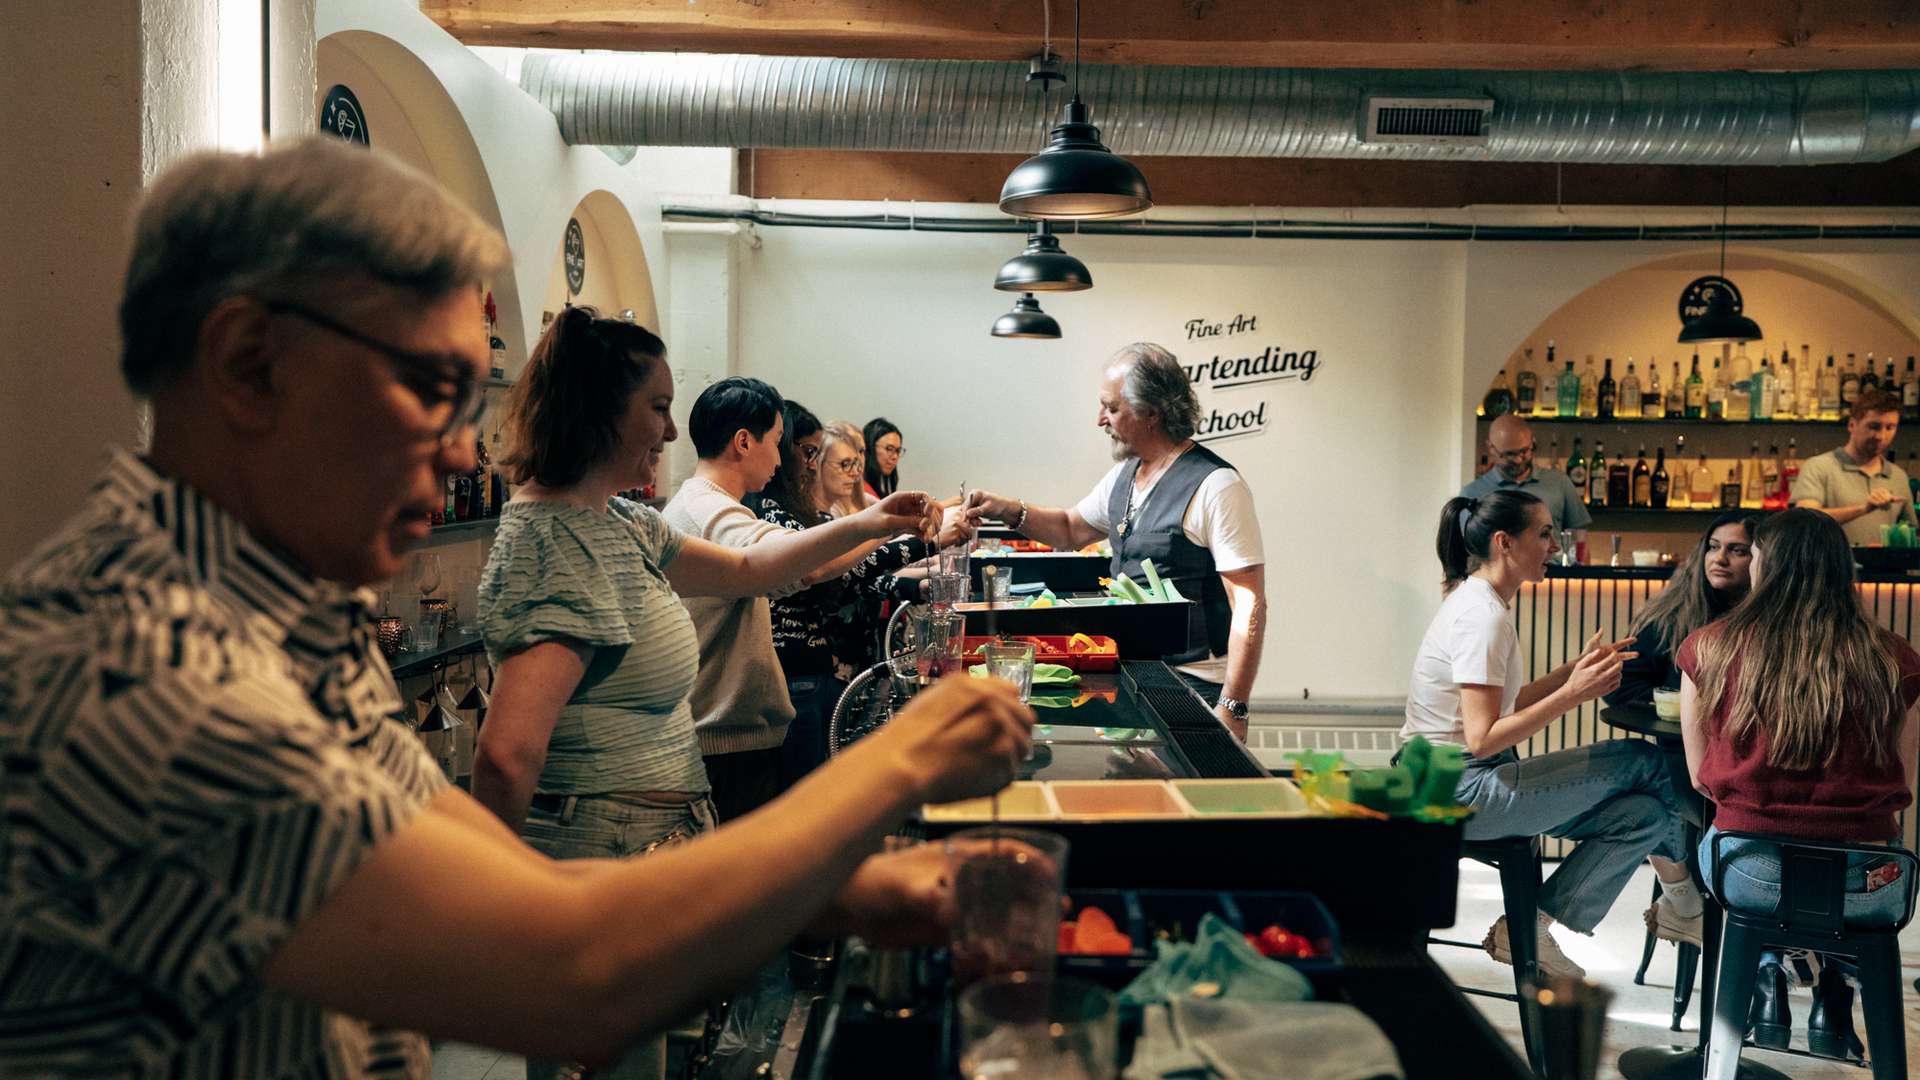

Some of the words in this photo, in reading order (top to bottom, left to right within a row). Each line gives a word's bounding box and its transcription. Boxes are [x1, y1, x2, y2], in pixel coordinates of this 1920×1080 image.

[1185, 318, 1223, 340] Fine
[1227, 313, 1257, 336] Art
[1182, 346, 1321, 382] artending
[1197, 401, 1267, 435] chool
